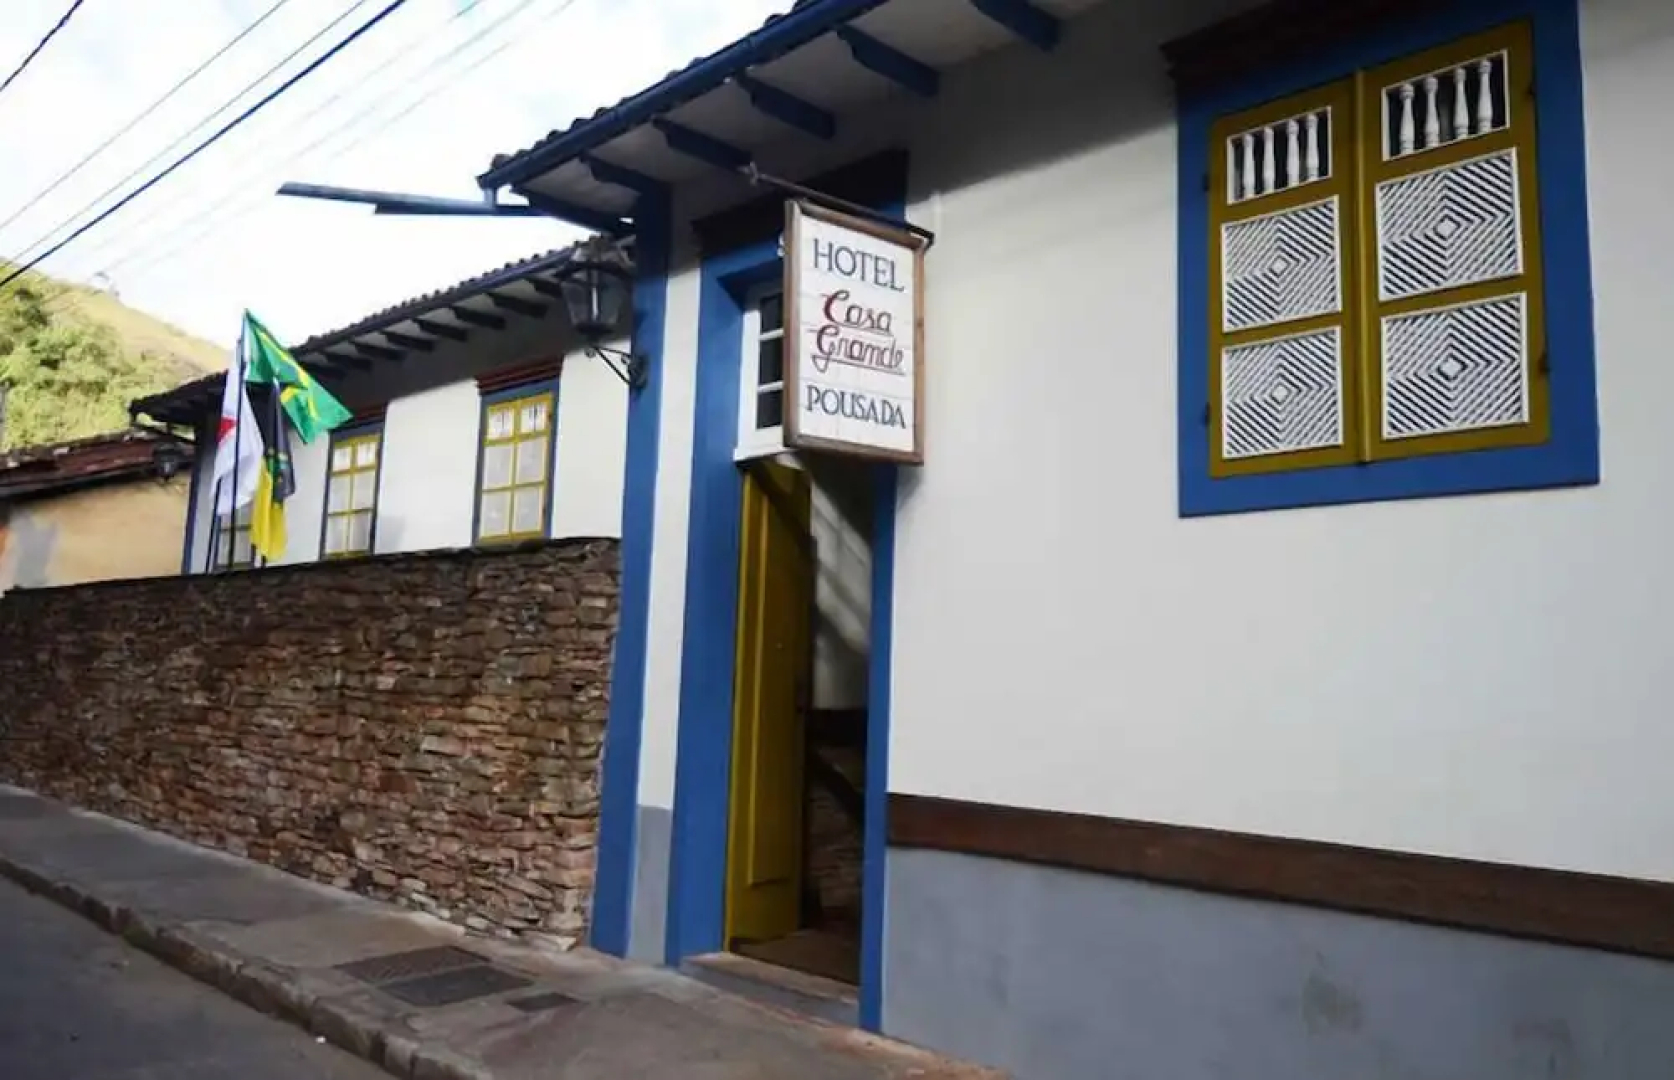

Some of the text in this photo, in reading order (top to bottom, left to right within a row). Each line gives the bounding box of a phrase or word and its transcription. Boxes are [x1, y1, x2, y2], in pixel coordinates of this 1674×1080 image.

[813, 238, 905, 292] HOTEL
[821, 289, 893, 334] Casa
[808, 325, 905, 375] Grande
[806, 385, 906, 429] POUSADA
